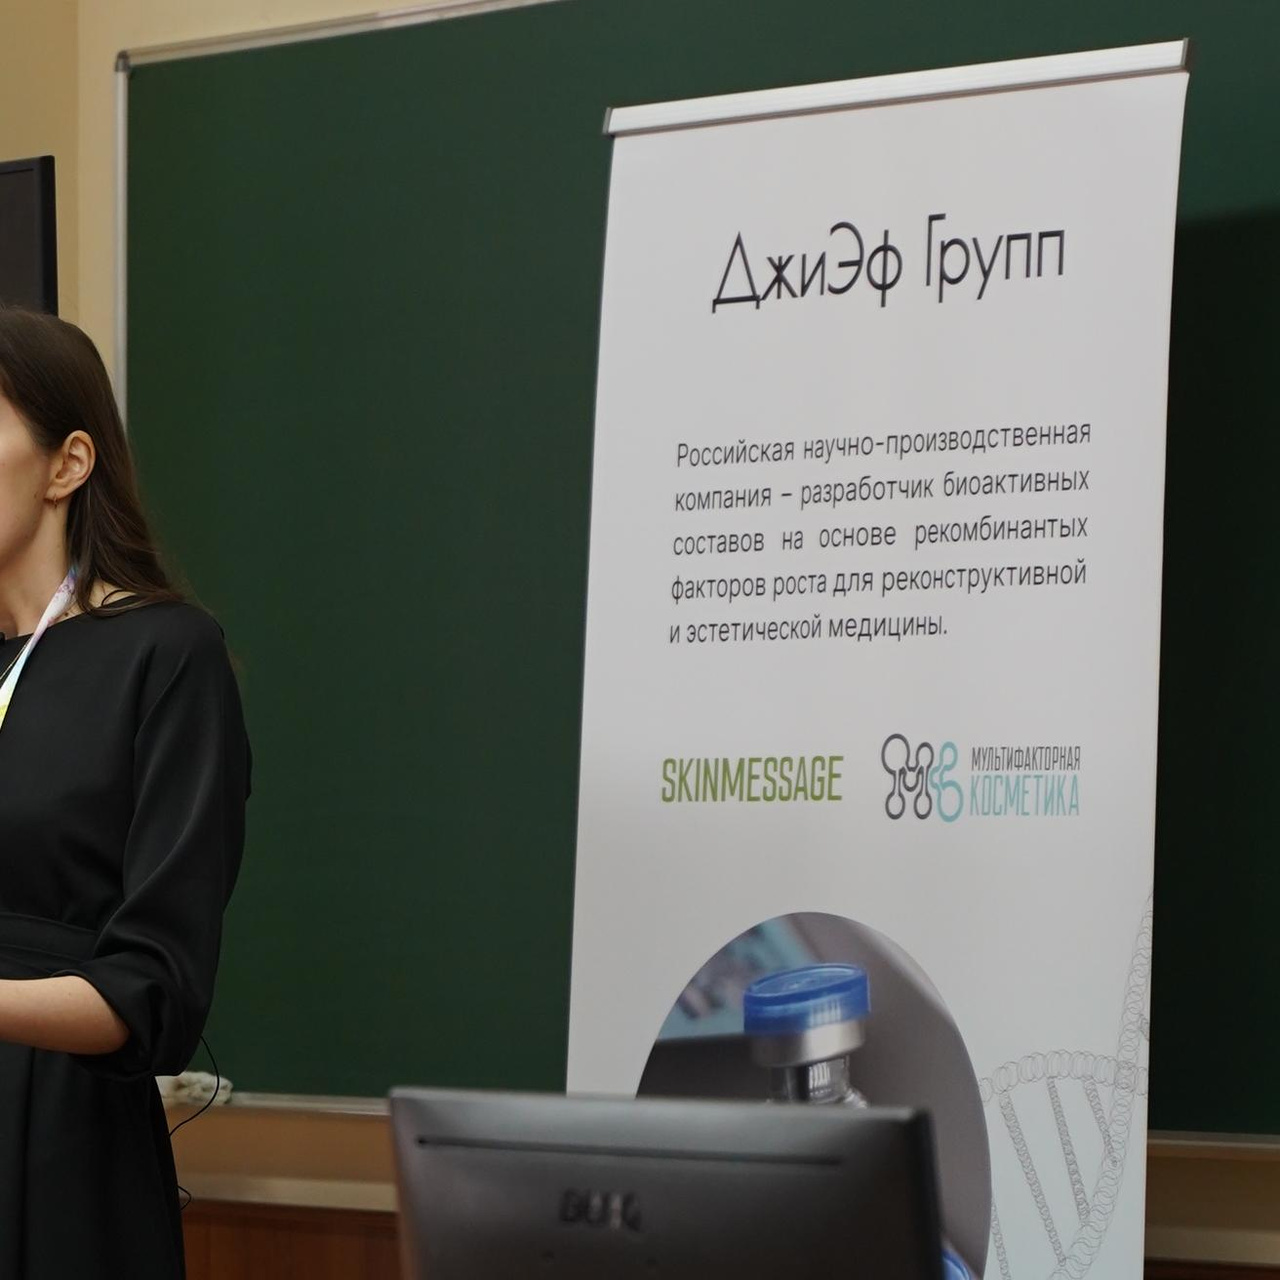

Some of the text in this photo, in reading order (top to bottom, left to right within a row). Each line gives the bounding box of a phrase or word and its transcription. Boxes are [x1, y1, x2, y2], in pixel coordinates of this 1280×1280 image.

[711, 213, 1066, 314] ДжиЭф Групп
[677, 423, 1091, 468] Российская научно-производственная
[675, 487, 772, 512] компания
[800, 475, 934, 511] разработчик
[943, 470, 1090, 498] биоактивных
[672, 514, 1089, 556] составов на основе рекомбинантых
[671, 557, 1087, 605] факторов роста для реконструктивной
[669, 612, 949, 645] и эстетической медицины.
[661, 755, 844, 804] SKINMESSAGE
[970, 745, 1082, 773] МУЛЬТИФАКТОРНАЯ
[969, 773, 1081, 817] КОСМЕТИКА
